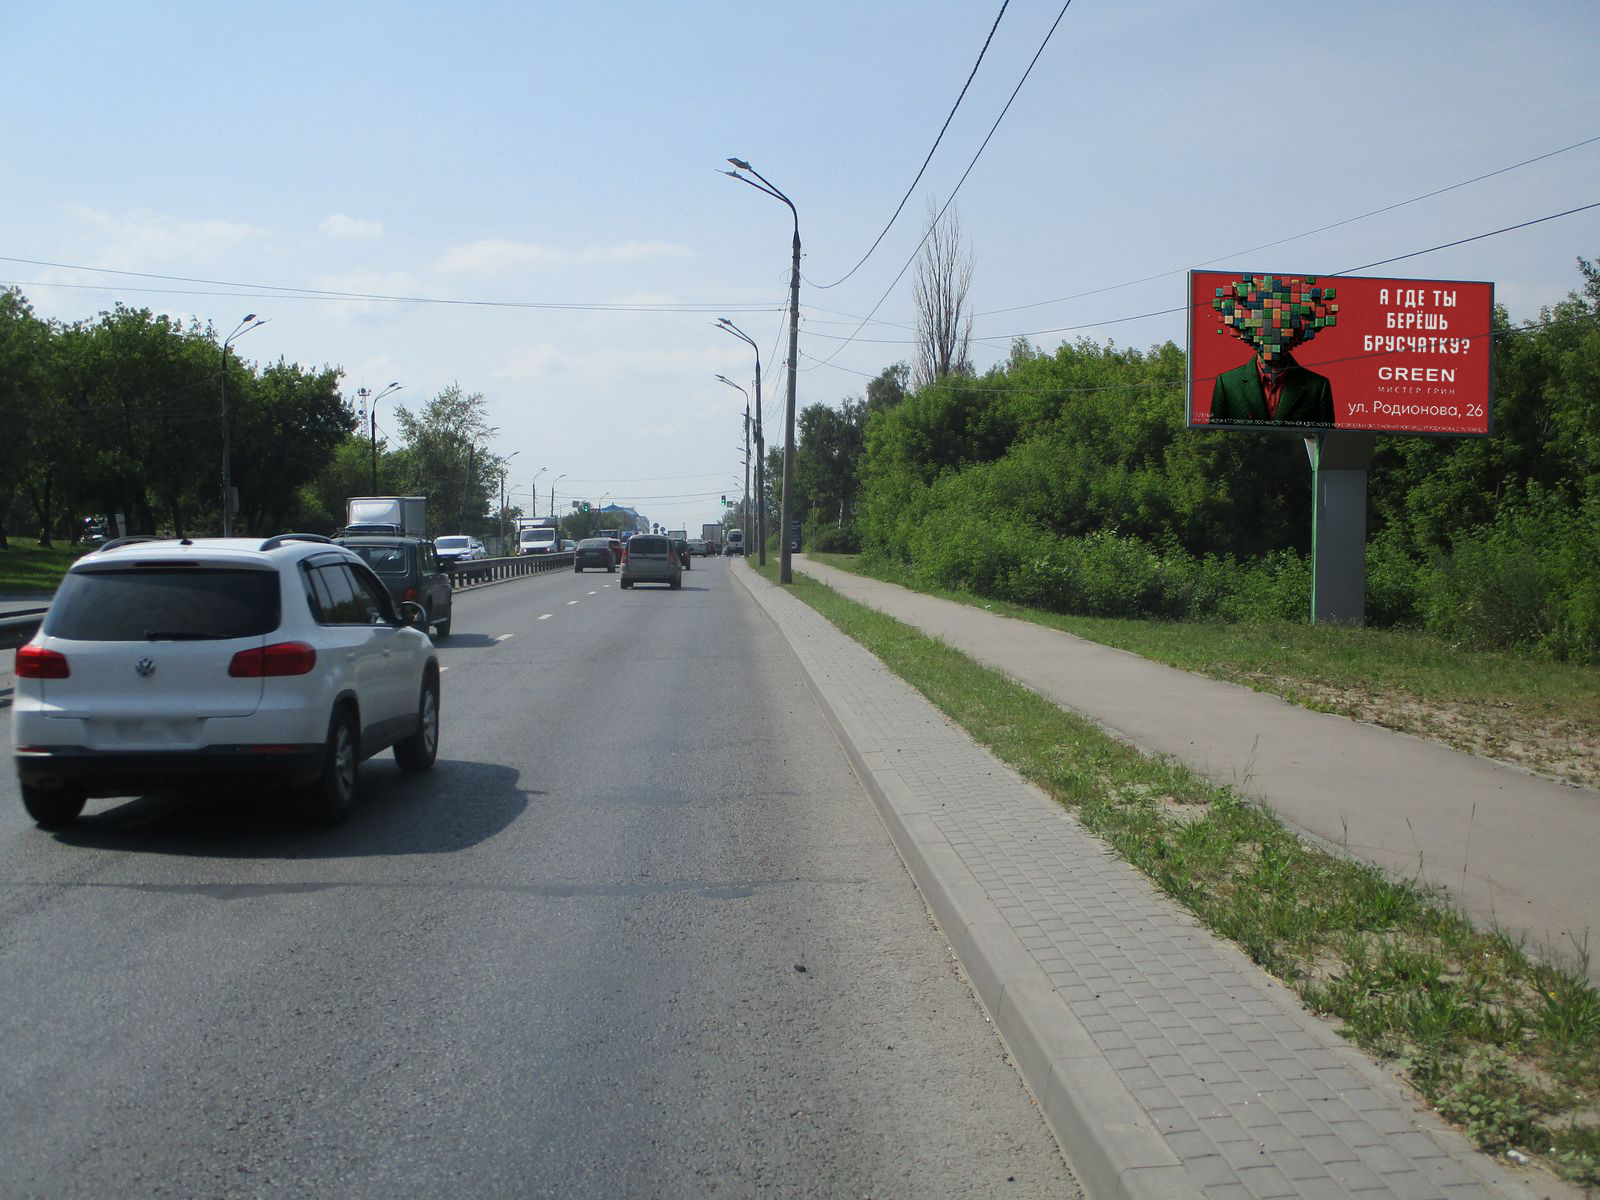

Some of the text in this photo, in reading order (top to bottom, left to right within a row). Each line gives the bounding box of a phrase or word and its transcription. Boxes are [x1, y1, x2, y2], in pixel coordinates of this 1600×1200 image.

[1379, 288, 1457, 309] А ГДЕ ТЫ
[1386, 310, 1449, 331] БЕРЁШЬ
[1363, 334, 1471, 355] БРУСЧАТКУ?
[1378, 366, 1455, 383] GREEN
[1377, 386, 1455, 395] МИСТЕР ГРИН
[1347, 400, 1484, 419] ул. Родионова, 26
